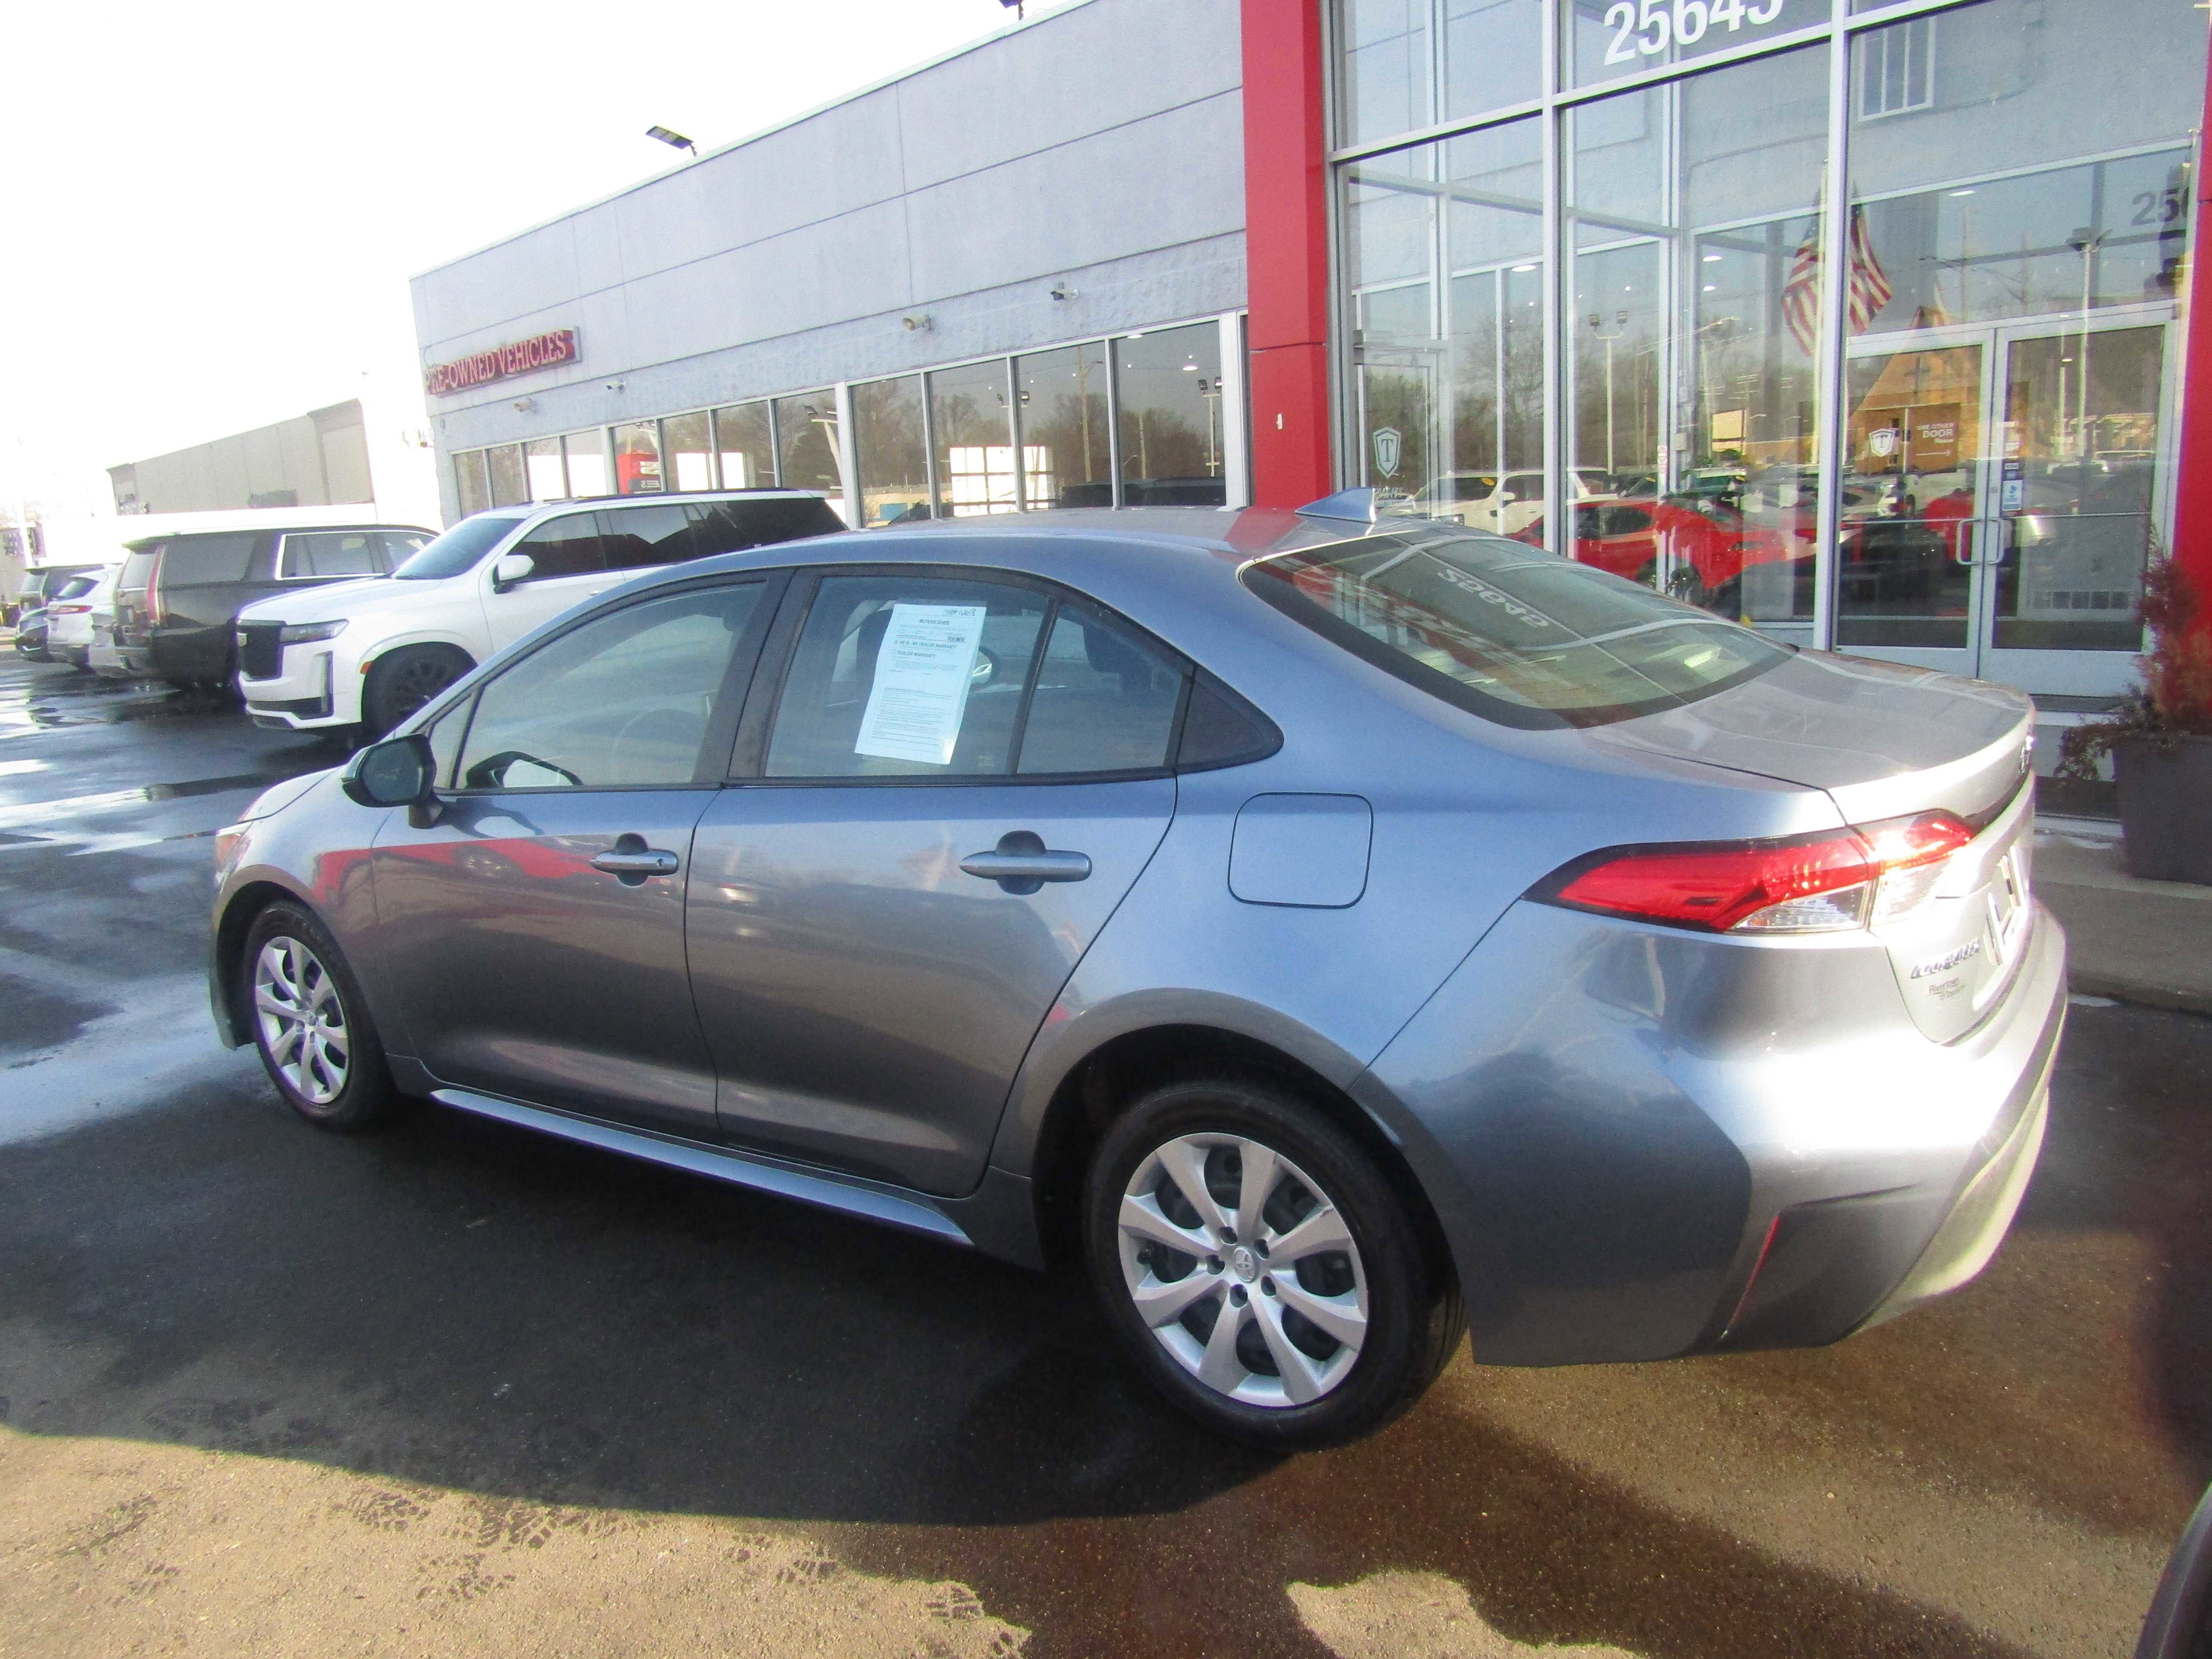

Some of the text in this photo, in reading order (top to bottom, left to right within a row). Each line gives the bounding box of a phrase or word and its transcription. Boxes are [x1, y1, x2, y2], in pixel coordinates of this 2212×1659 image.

[424, 330, 568, 393] PRE-OWNED VEHICLES
[1922, 428, 1953, 438] DOOR
[1381, 438, 1393, 462] T
